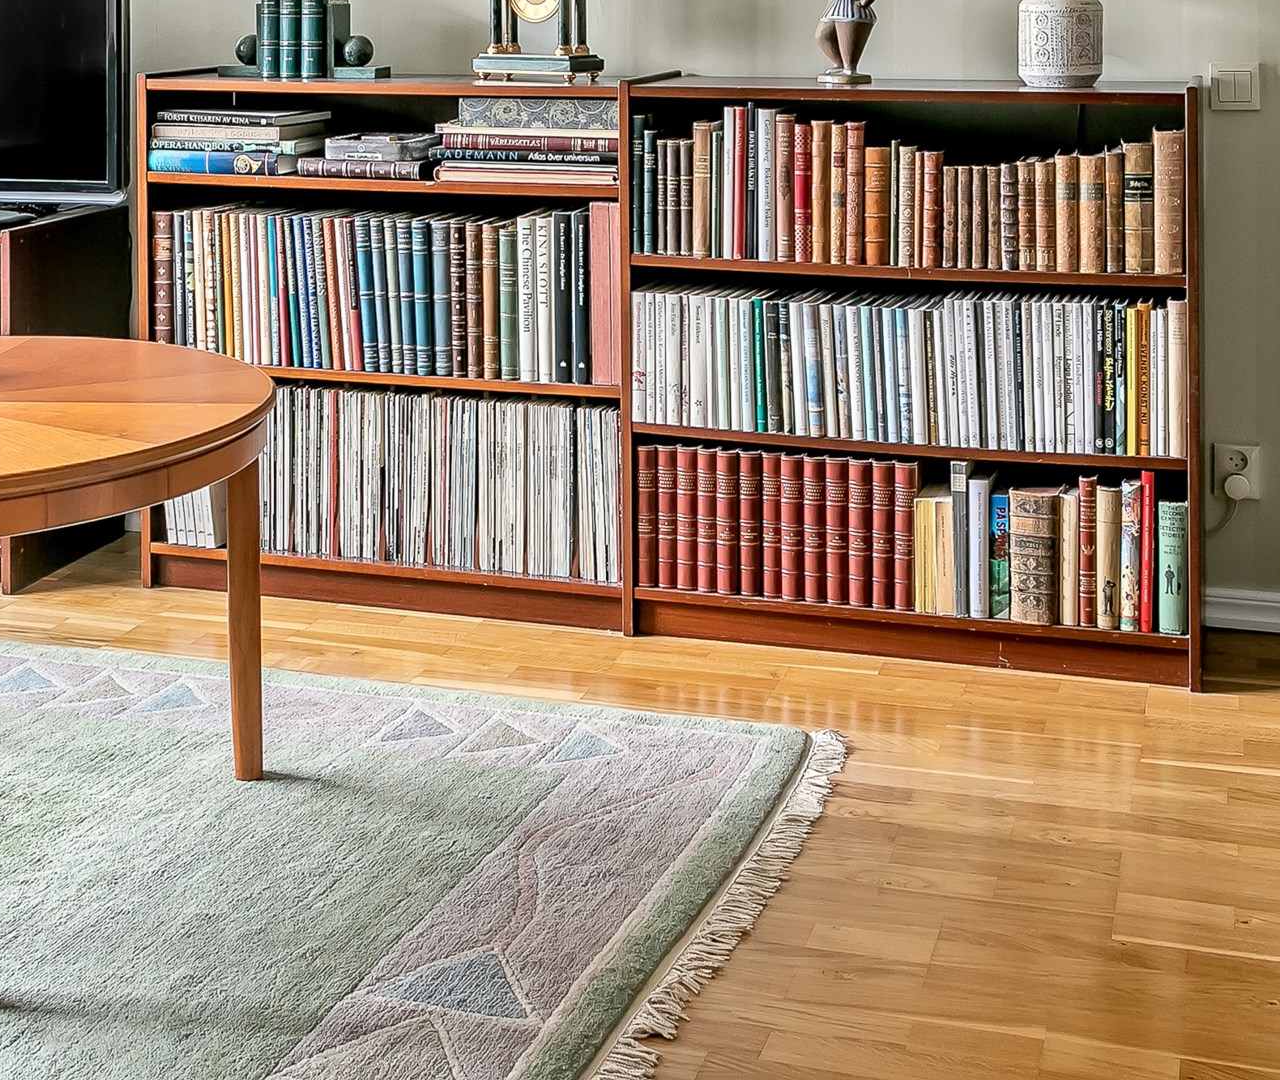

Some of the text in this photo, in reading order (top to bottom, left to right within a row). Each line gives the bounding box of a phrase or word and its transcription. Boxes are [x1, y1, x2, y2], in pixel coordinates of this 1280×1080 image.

[222, 116, 231, 124] AV
[232, 116, 250, 125] KINA
[436, 149, 600, 162] LADEMANN Atlas över universum
[304, 220, 312, 247] EUGEN
[538, 225, 548, 257] KINA
[312, 219, 326, 297] CARL MILLES
[521, 225, 534, 333] The Chinese Pavilion
[1066, 309, 1074, 333] Thomas
[986, 326, 994, 360] NILSSON
[1096, 330, 1104, 352] Millroth
[1140, 343, 1148, 378] SVENSK
[1140, 380, 1148, 410] KONST
[1140, 412, 1148, 425] NU
[1160, 515, 1185, 523] CENTURY
